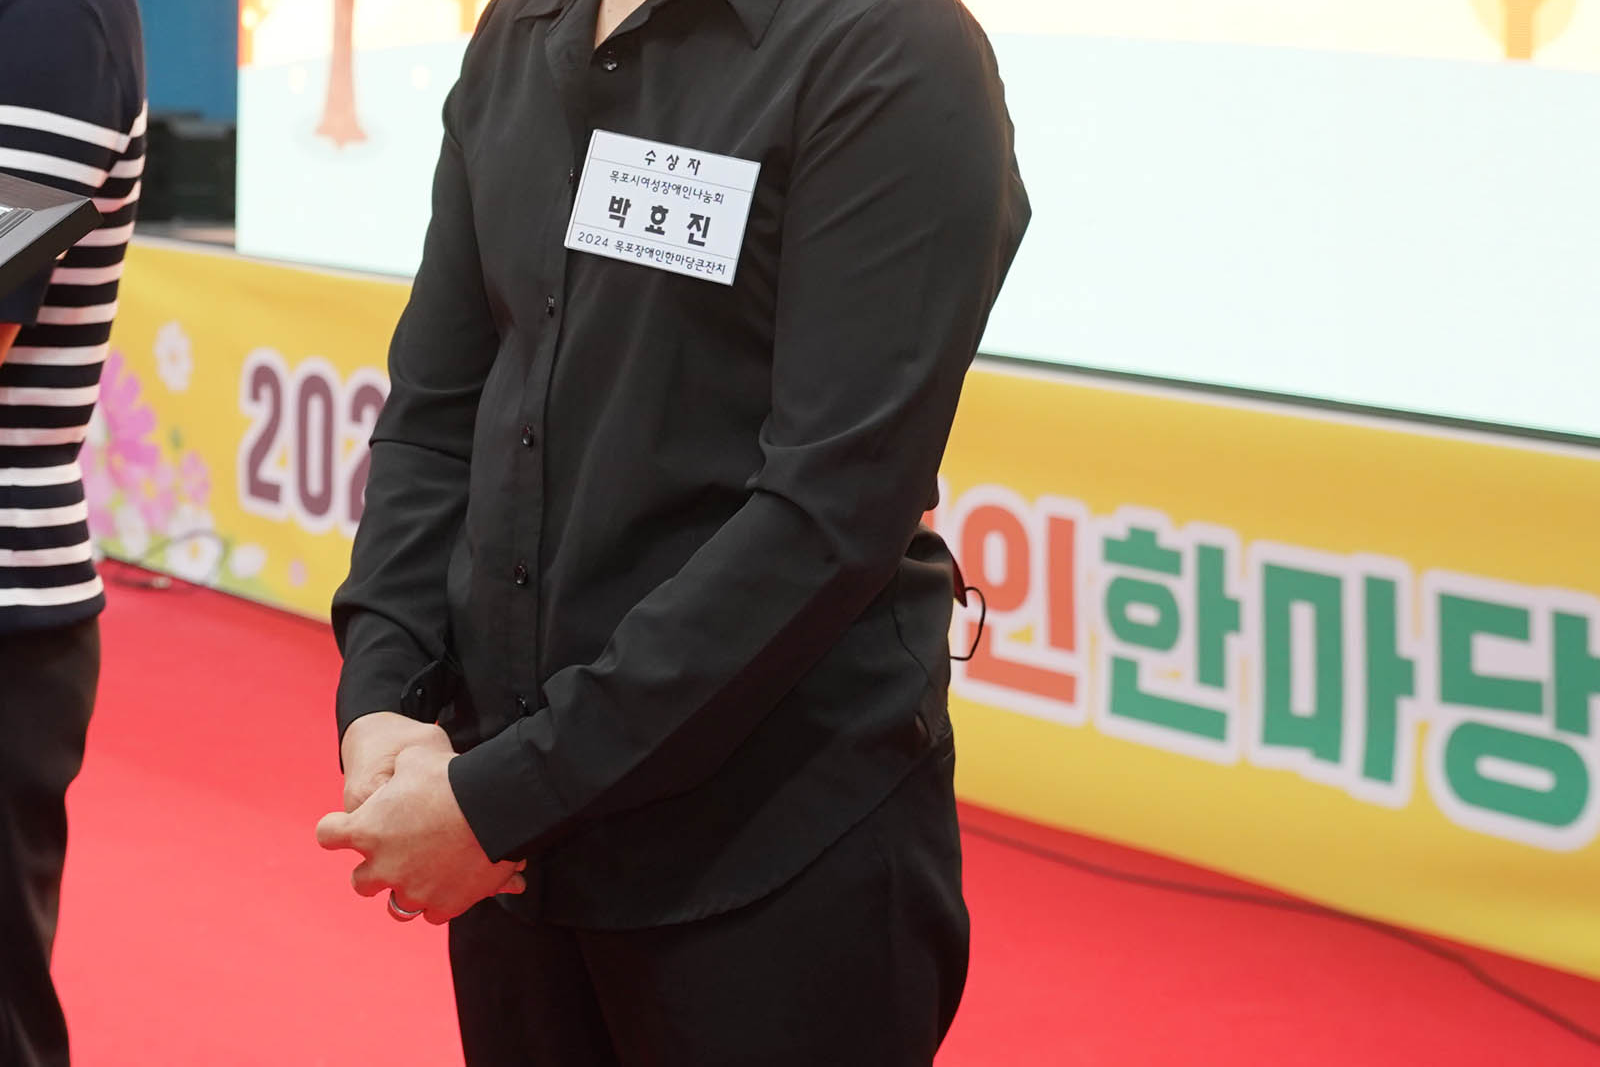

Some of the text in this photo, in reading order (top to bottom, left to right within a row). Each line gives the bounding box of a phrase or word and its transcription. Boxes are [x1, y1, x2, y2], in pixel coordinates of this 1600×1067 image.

[609, 170, 725, 204] 목포시여성장애인나눔회
[577, 231, 726, 276] 2024 목포장애인한마당큰잔치
